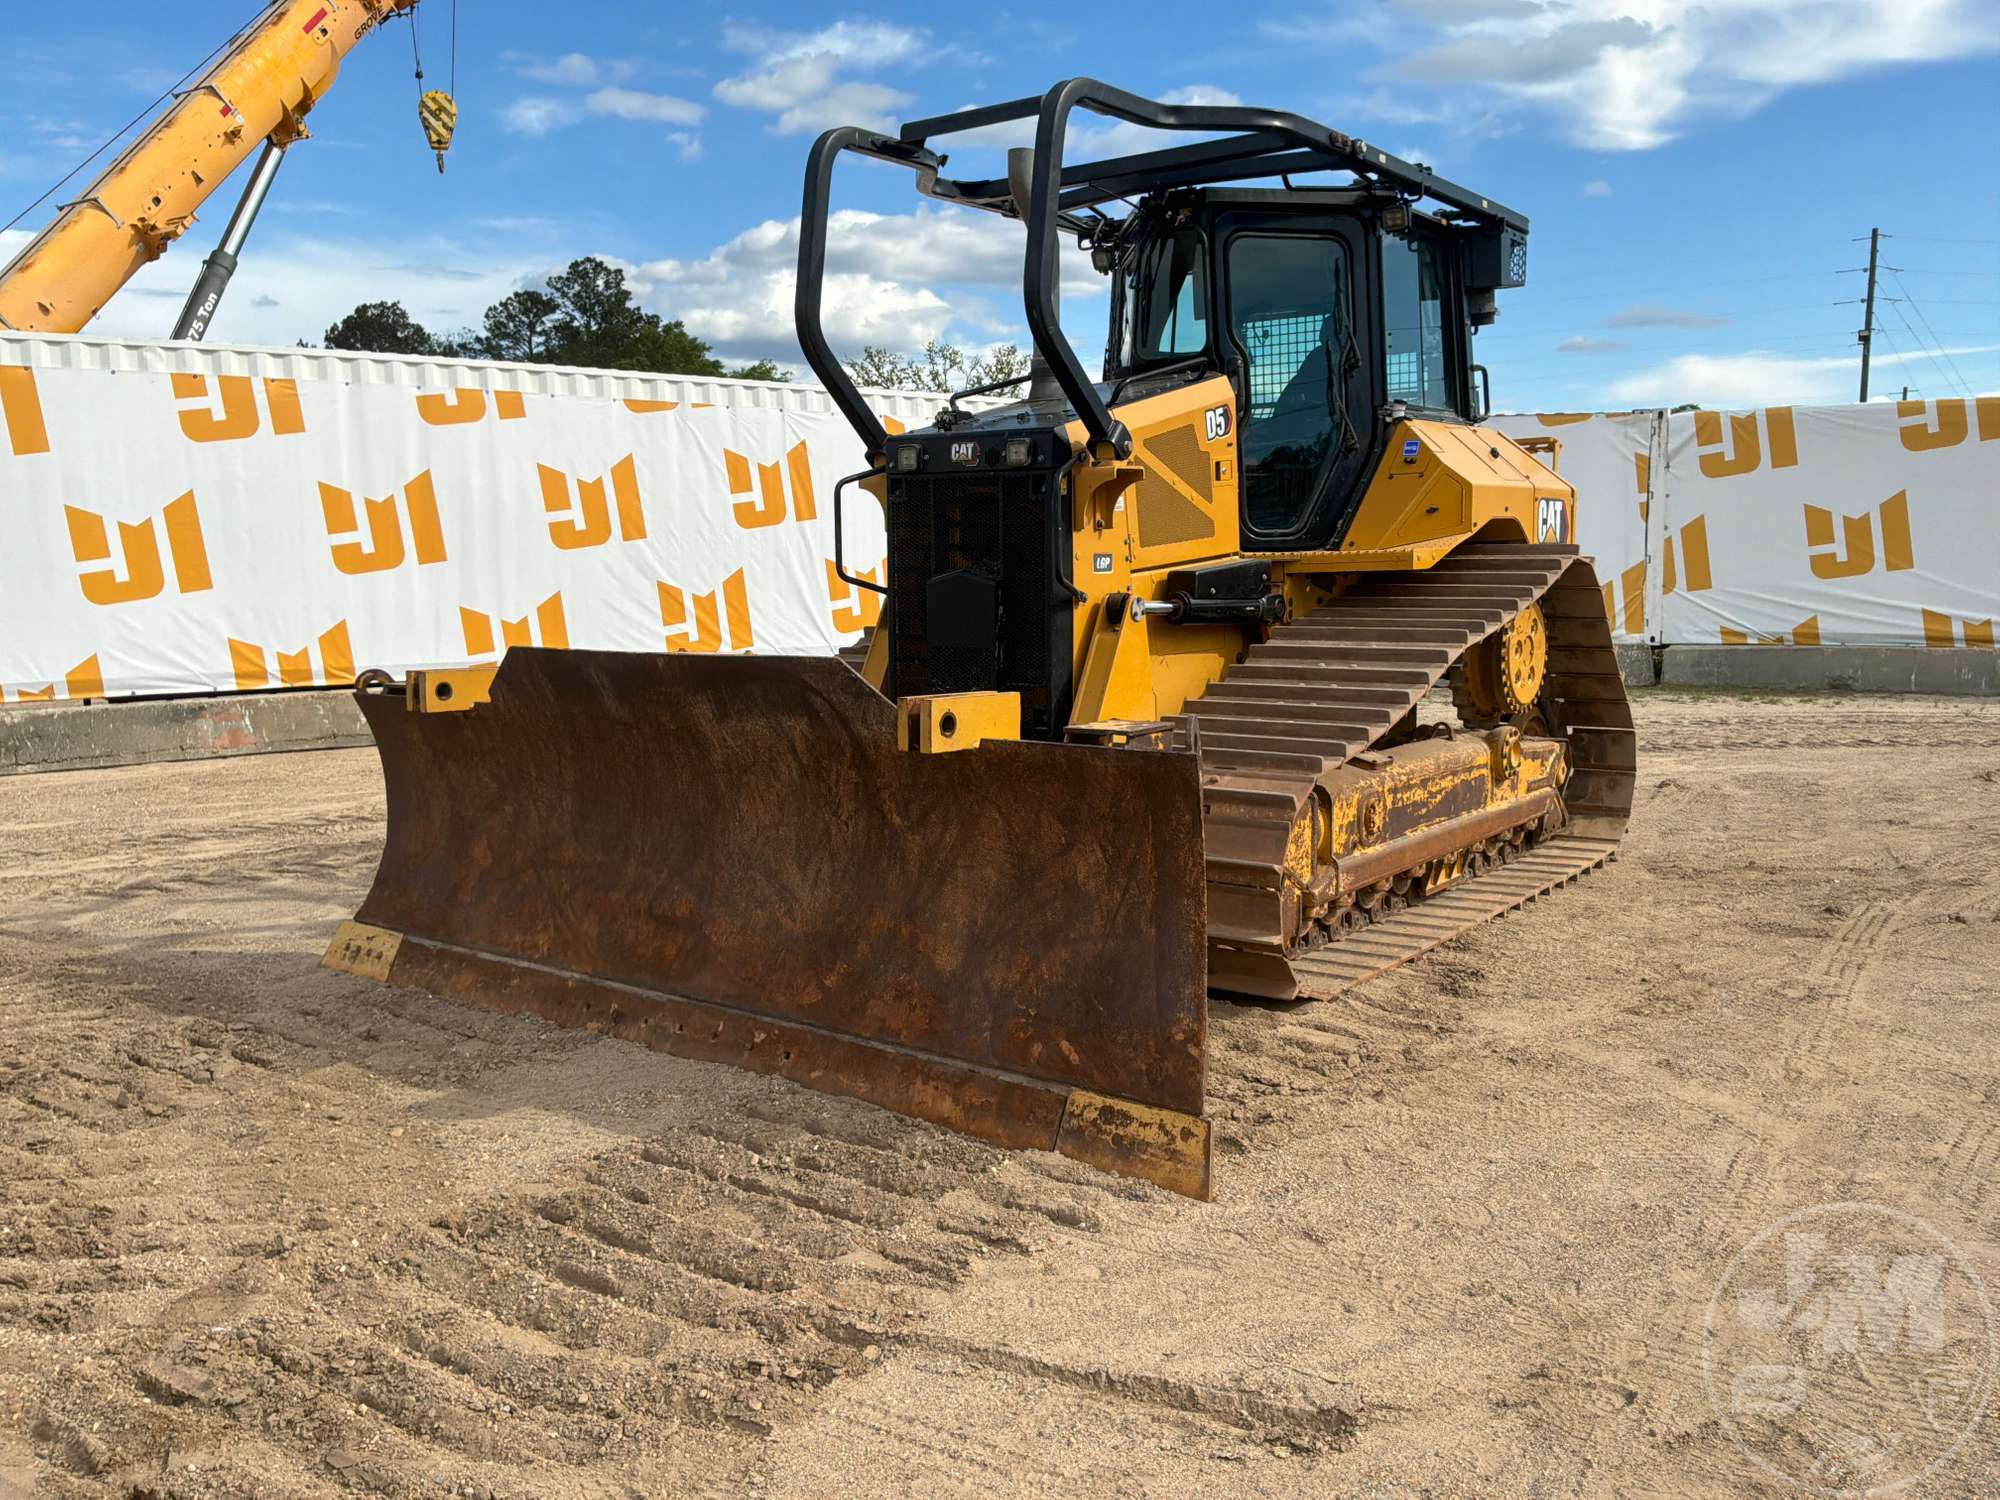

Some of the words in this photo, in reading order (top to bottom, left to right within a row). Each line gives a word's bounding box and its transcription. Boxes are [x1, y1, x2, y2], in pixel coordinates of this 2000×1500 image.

[186, 319, 204, 341] 75
[197, 292, 218, 319] Ton
[1205, 406, 1226, 440] D5
[951, 442, 975, 461] CAT
[1538, 499, 1563, 544] CAT
[1096, 556, 1111, 569] LGP
